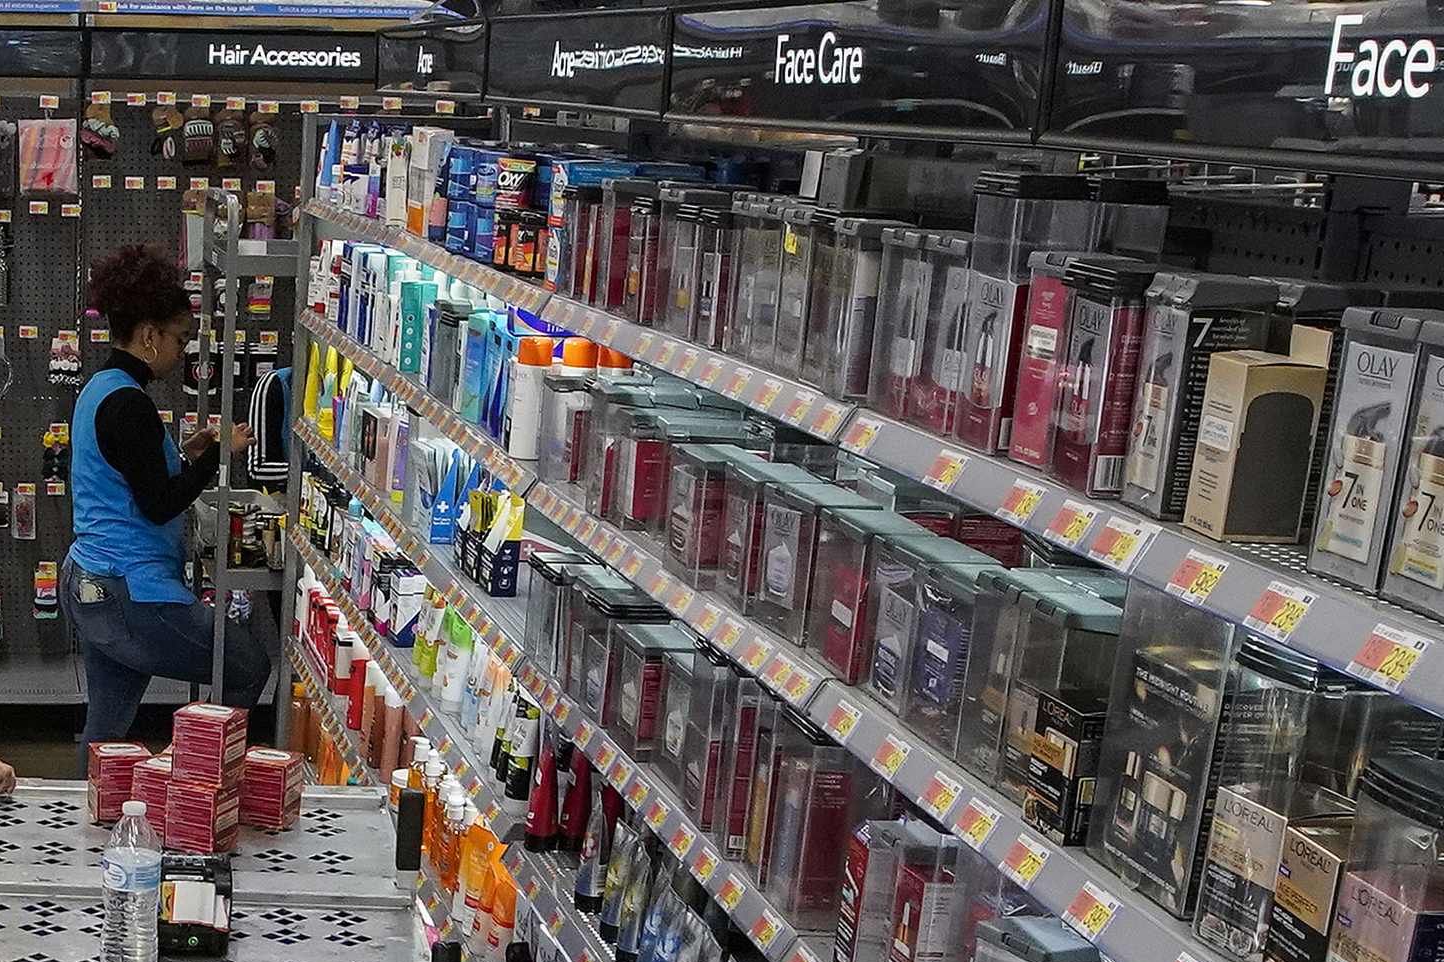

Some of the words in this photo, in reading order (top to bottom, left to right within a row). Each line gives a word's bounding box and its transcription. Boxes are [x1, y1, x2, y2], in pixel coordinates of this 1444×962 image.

[208, 44, 250, 65] Hair
[251, 45, 361, 67] Accessories
[775, 34, 815, 84] Face
[819, 32, 863, 84] Care
[1324, 14, 1437, 98] Face
[498, 172, 523, 188] OXY
[1079, 305, 1103, 331] OLAY
[1192, 317, 1213, 348] 7
[1357, 351, 1400, 378] OLAY
[1341, 470, 1359, 509] 7
[1351, 499, 1368, 512] ONE
[1418, 491, 1436, 531] 7
